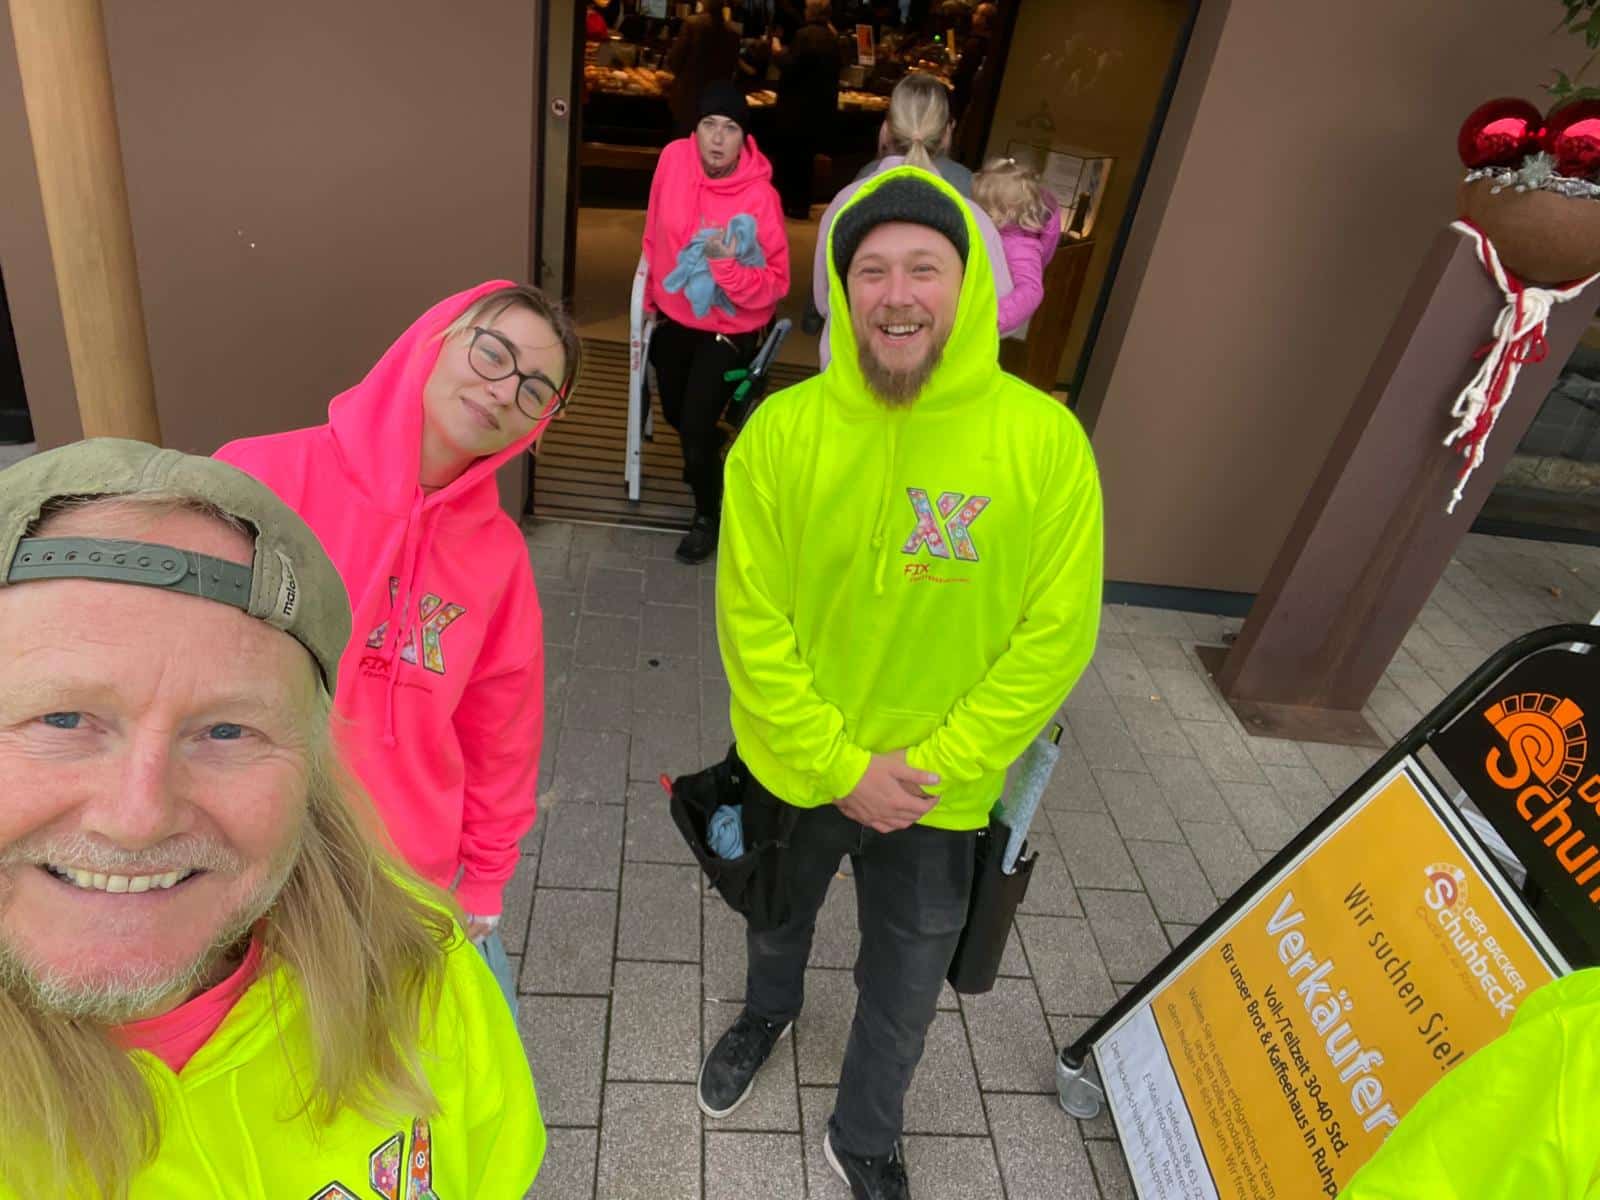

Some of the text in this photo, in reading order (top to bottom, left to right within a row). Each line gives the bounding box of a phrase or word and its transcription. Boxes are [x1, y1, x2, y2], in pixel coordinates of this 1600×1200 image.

[904, 563, 930, 576] FIX
[1423, 878, 1516, 1018] Schuhbeck
[1462, 907, 1488, 937] DER
[1265, 891, 1400, 1136] Verkäufer
[1343, 882, 1375, 927] Wir
[1368, 931, 1424, 1015] suchen
[1417, 1012, 1465, 1071] Sie!
[1220, 943, 1235, 964] für
[1230, 963, 1252, 1001] unser
[1246, 999, 1266, 1034] Brot
[1259, 1031, 1273, 1047] &
[1266, 1043, 1310, 1130] Kaffeehaus
[1303, 1127, 1317, 1149] in
[1263, 983, 1311, 1078] Voll-/Teilzeit
[1325, 1121, 1350, 1159] Std.
[1222, 1110, 1245, 1157] Produkt
[1224, 1153, 1238, 1177] Wir
[1257, 1163, 1276, 1200] Team
